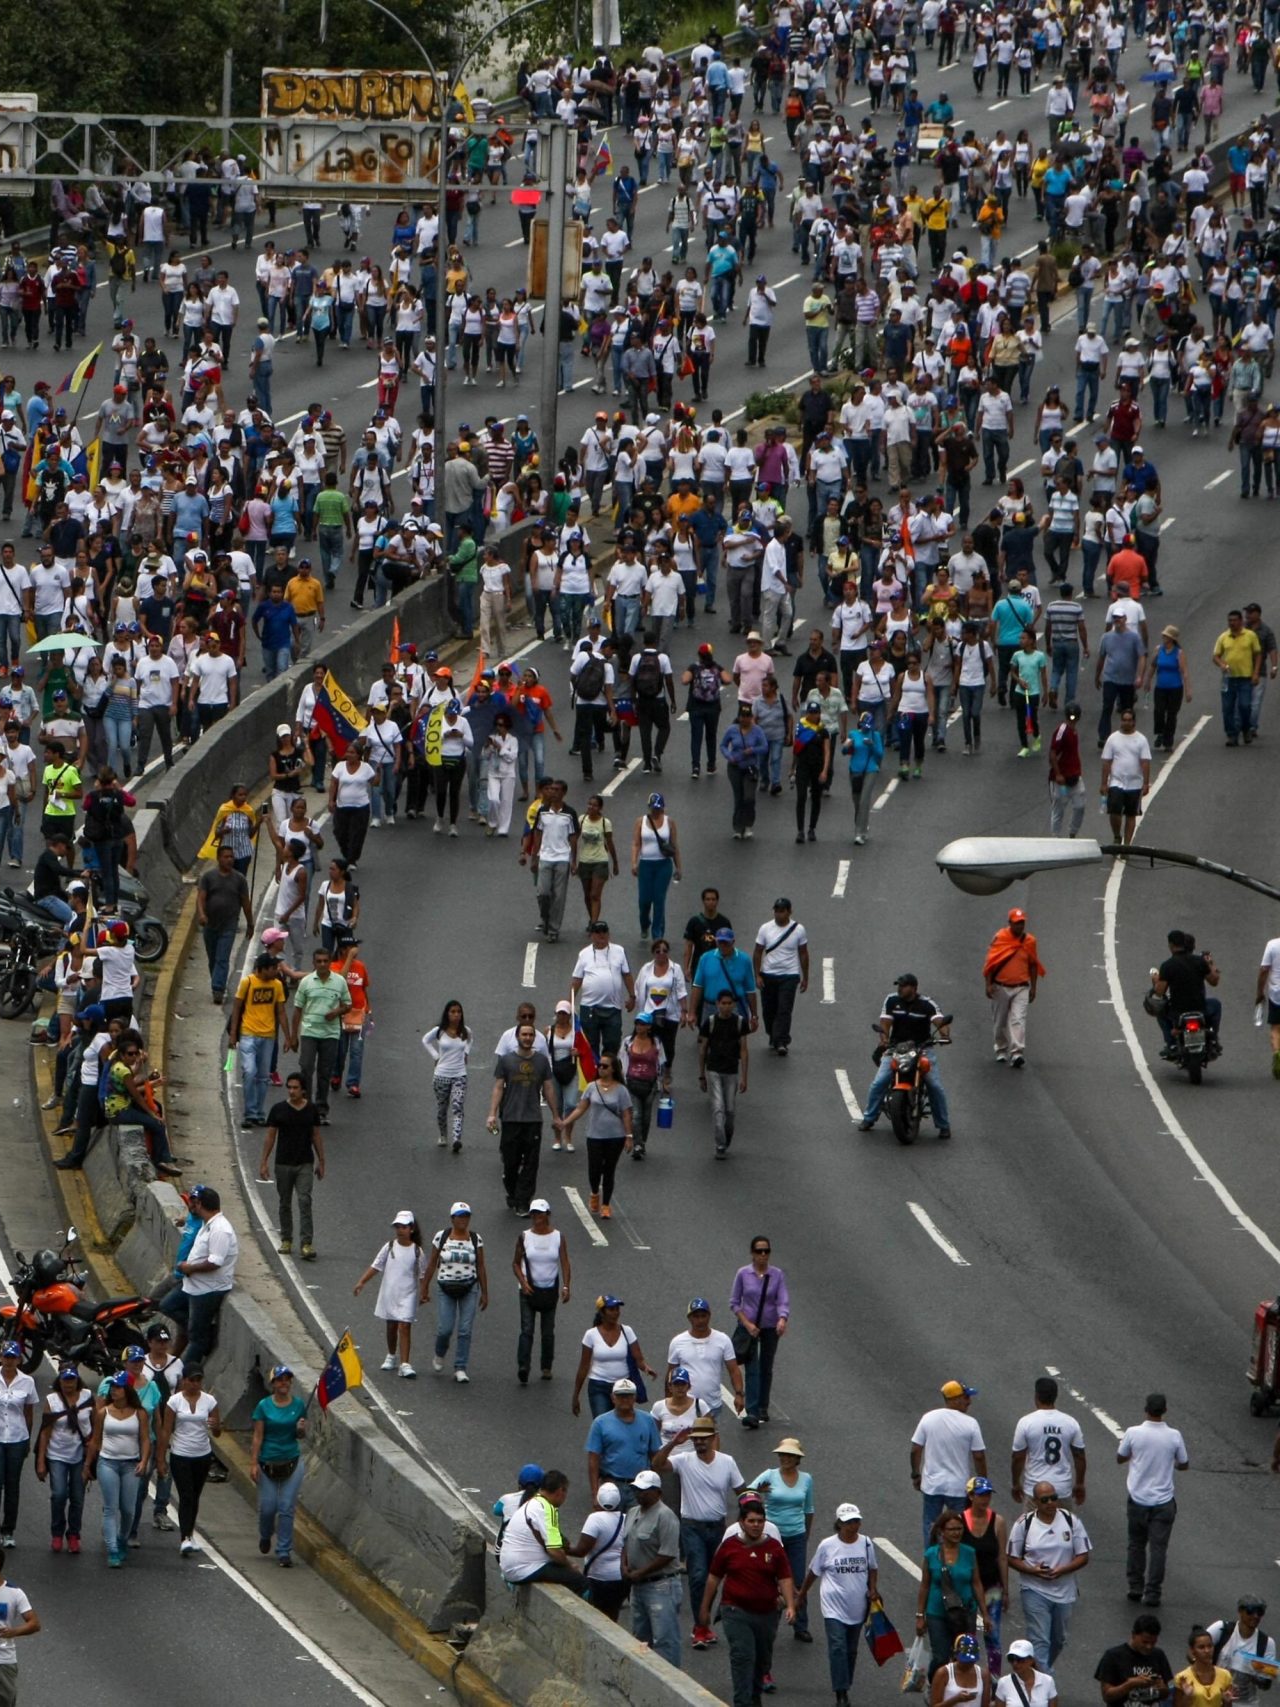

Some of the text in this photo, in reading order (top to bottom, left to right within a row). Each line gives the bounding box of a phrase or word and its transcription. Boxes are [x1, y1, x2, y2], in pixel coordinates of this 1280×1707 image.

[263, 73, 357, 115] DON
[330, 688, 358, 726] SOS
[426, 719, 442, 755] SOS
[1044, 1436, 1062, 1466] 8
